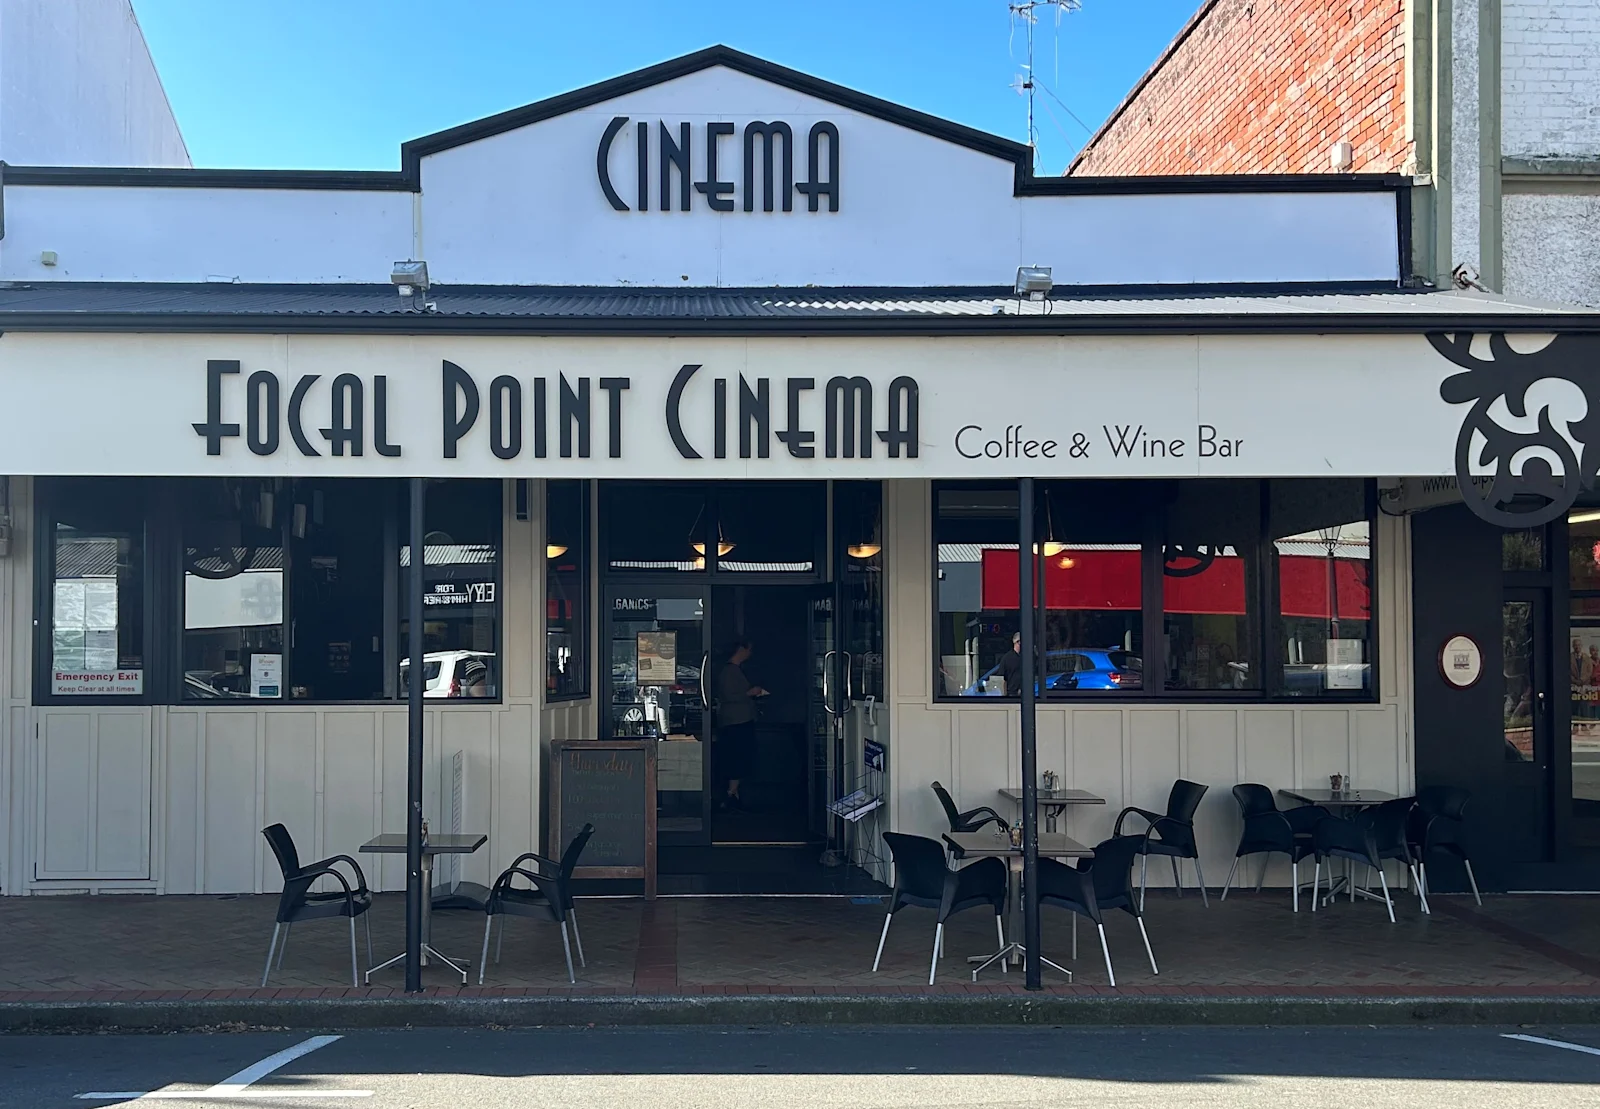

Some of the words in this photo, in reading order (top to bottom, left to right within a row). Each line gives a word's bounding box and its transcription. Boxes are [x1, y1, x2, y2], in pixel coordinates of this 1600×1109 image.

[597, 117, 840, 212] CINEMA
[192, 359, 402, 457] FOCAL
[443, 359, 631, 460] POINT
[666, 364, 920, 459] CINEMA
[955, 425, 1058, 458] Coffee
[1069, 433, 1091, 459] &
[1103, 425, 1186, 457] Wine
[1198, 425, 1244, 457] Bar
[55, 672, 115, 682] Emergency
[118, 672, 138, 681] Exit
